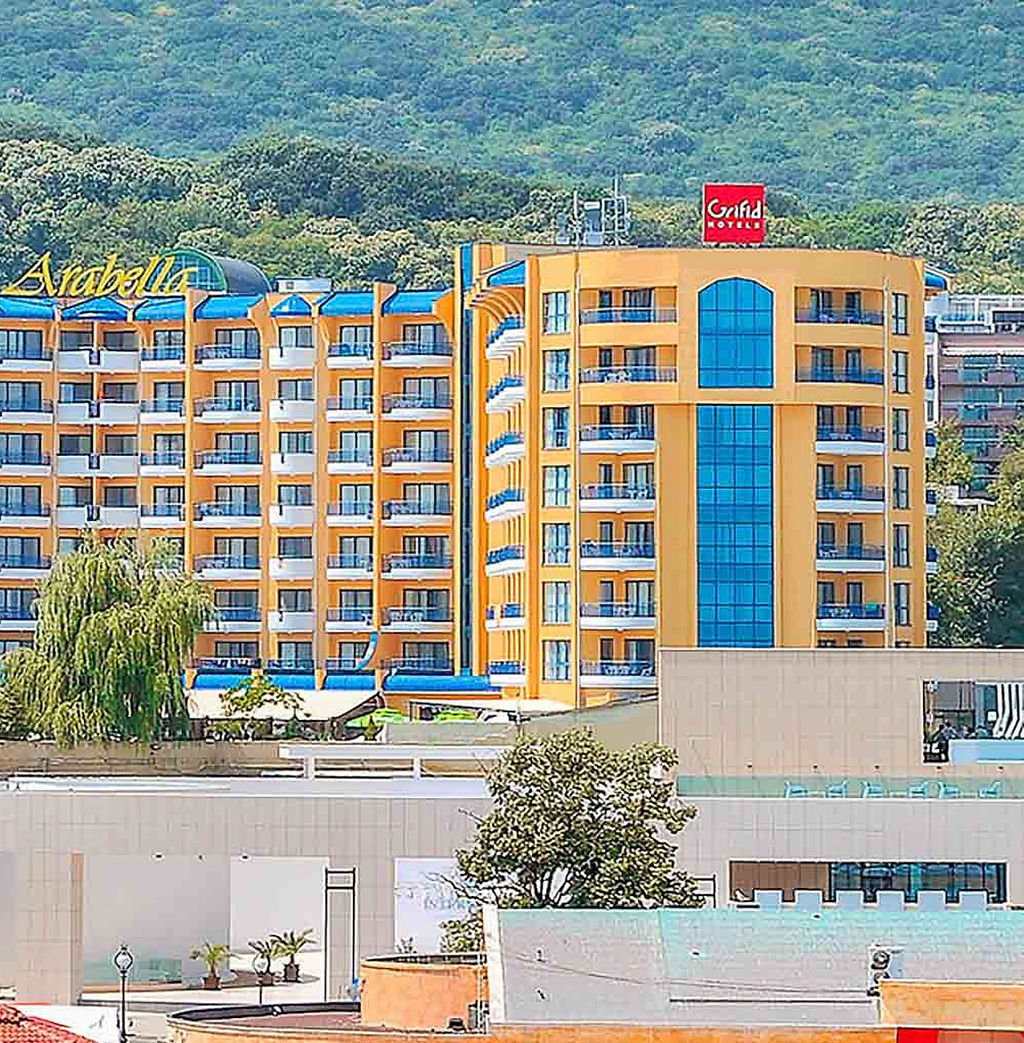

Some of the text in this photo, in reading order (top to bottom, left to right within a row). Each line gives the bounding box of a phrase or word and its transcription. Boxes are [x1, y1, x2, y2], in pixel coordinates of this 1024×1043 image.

[707, 198, 762, 219] Grifid
[707, 221, 760, 229] HOTELS
[1, 250, 198, 297] Arabella
